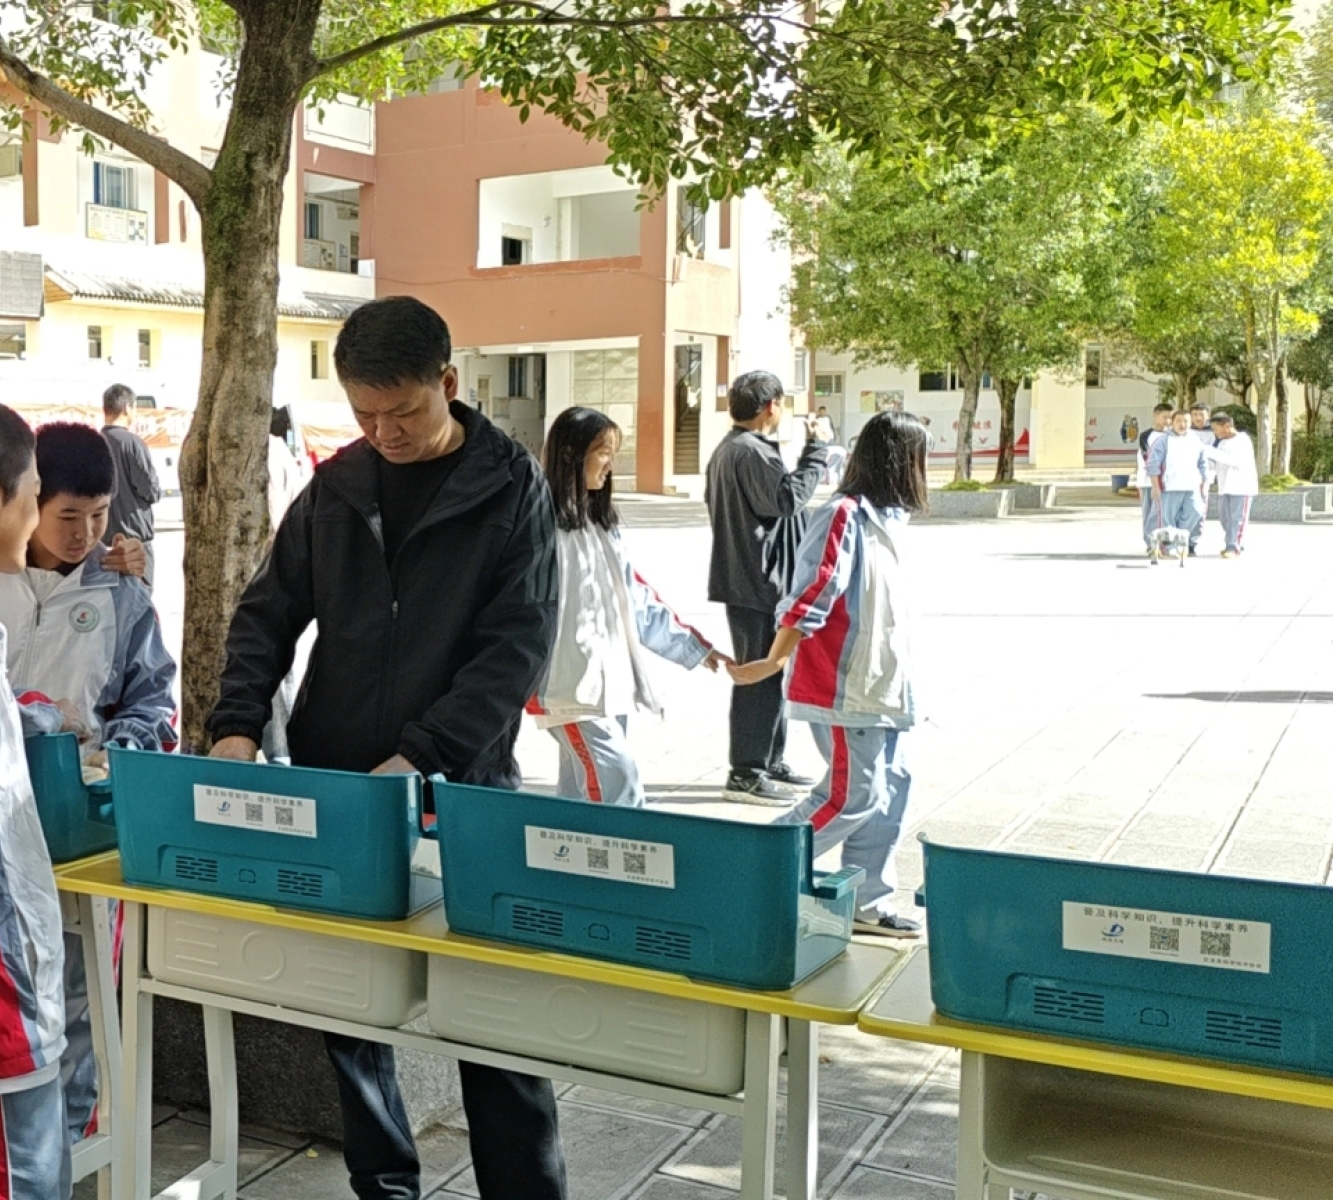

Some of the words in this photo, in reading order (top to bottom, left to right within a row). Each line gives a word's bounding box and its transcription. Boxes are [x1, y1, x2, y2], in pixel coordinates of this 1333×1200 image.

[1083, 906, 1249, 933] 普及科学知识，提升科学素养
